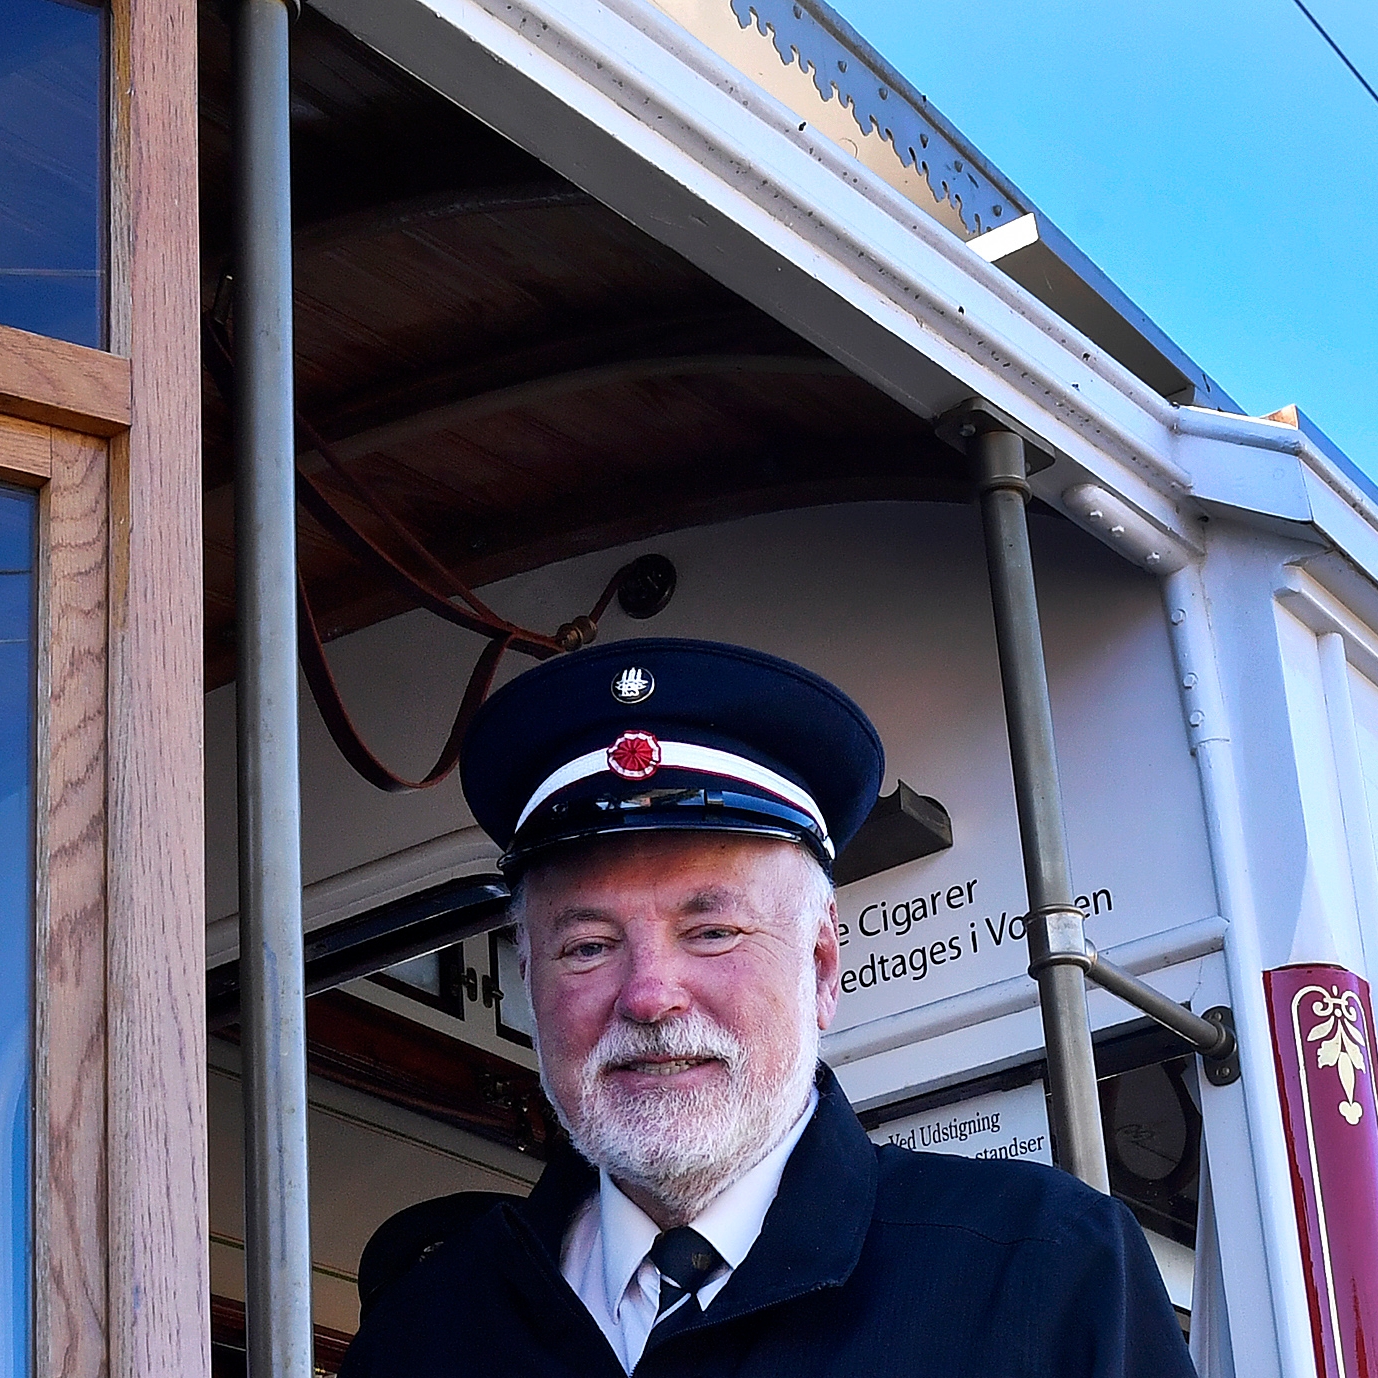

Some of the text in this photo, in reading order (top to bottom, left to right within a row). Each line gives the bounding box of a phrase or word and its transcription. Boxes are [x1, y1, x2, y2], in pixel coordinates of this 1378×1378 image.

[858, 878, 978, 936] Cigarer
[840, 887, 1113, 994] edtages i Voen
[919, 1112, 1001, 1147] Udstigning
